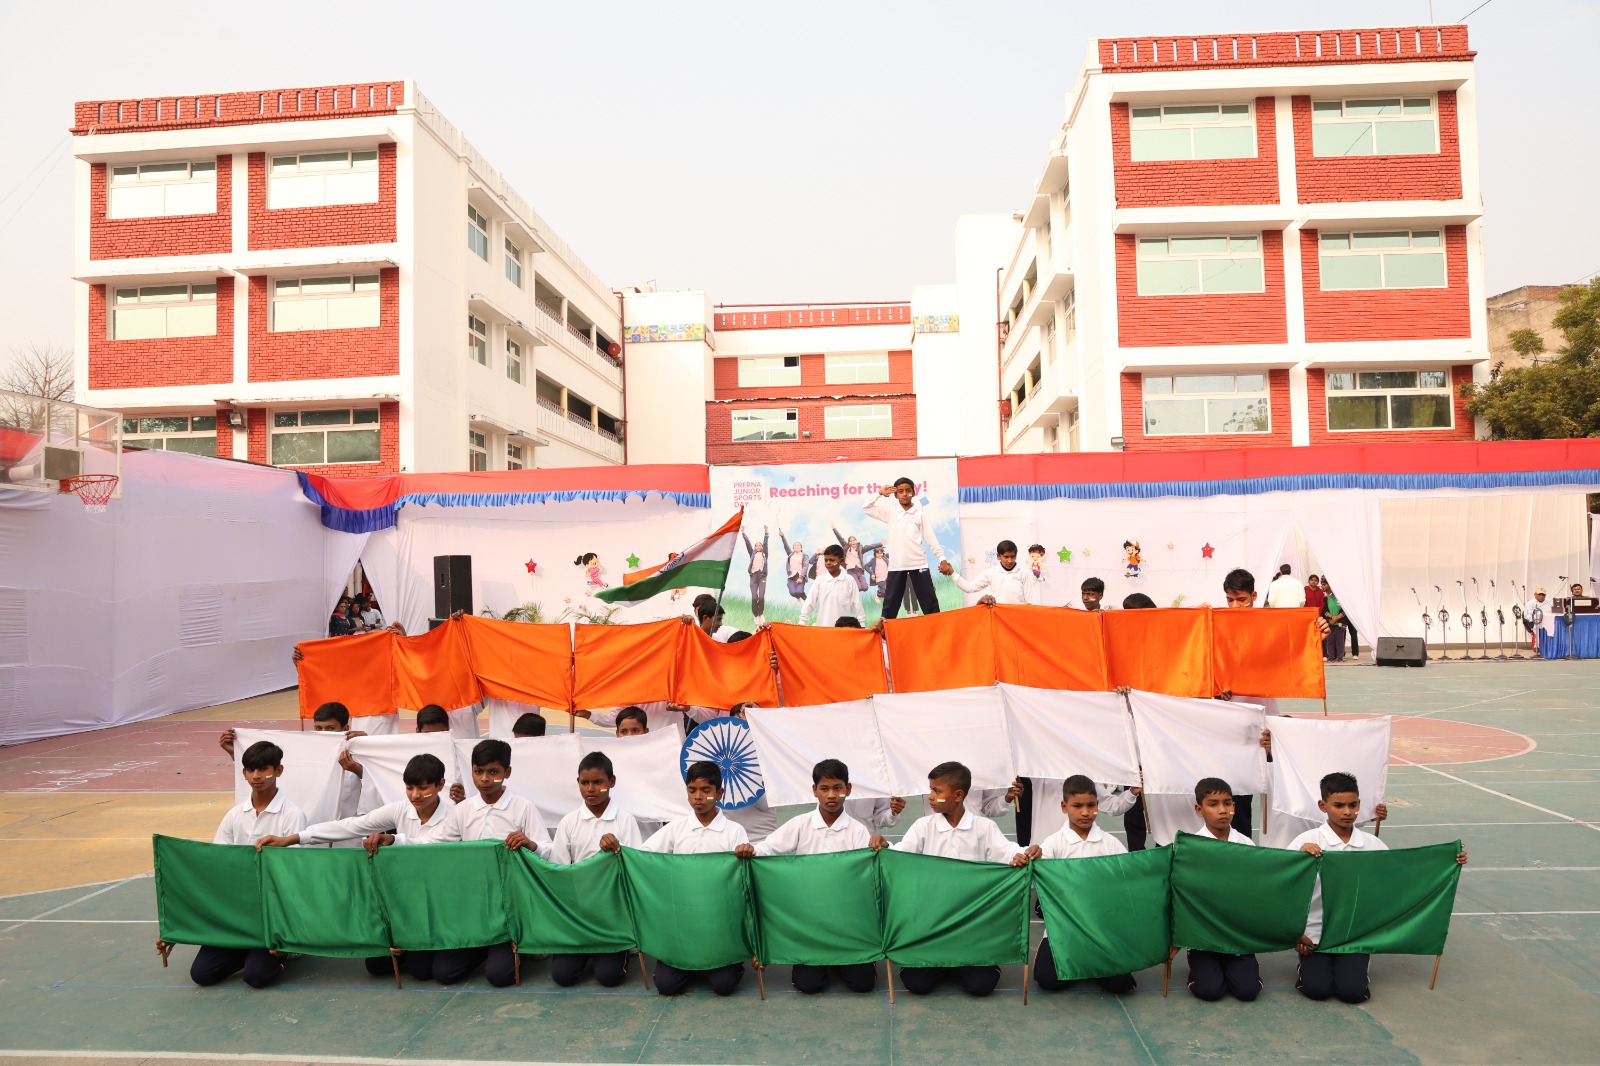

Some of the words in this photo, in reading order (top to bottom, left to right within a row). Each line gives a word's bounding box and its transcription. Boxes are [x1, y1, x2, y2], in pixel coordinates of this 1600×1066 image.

[770, 484, 840, 499] Reaching
[843, 483, 864, 495] for
[866, 483, 882, 494] th
